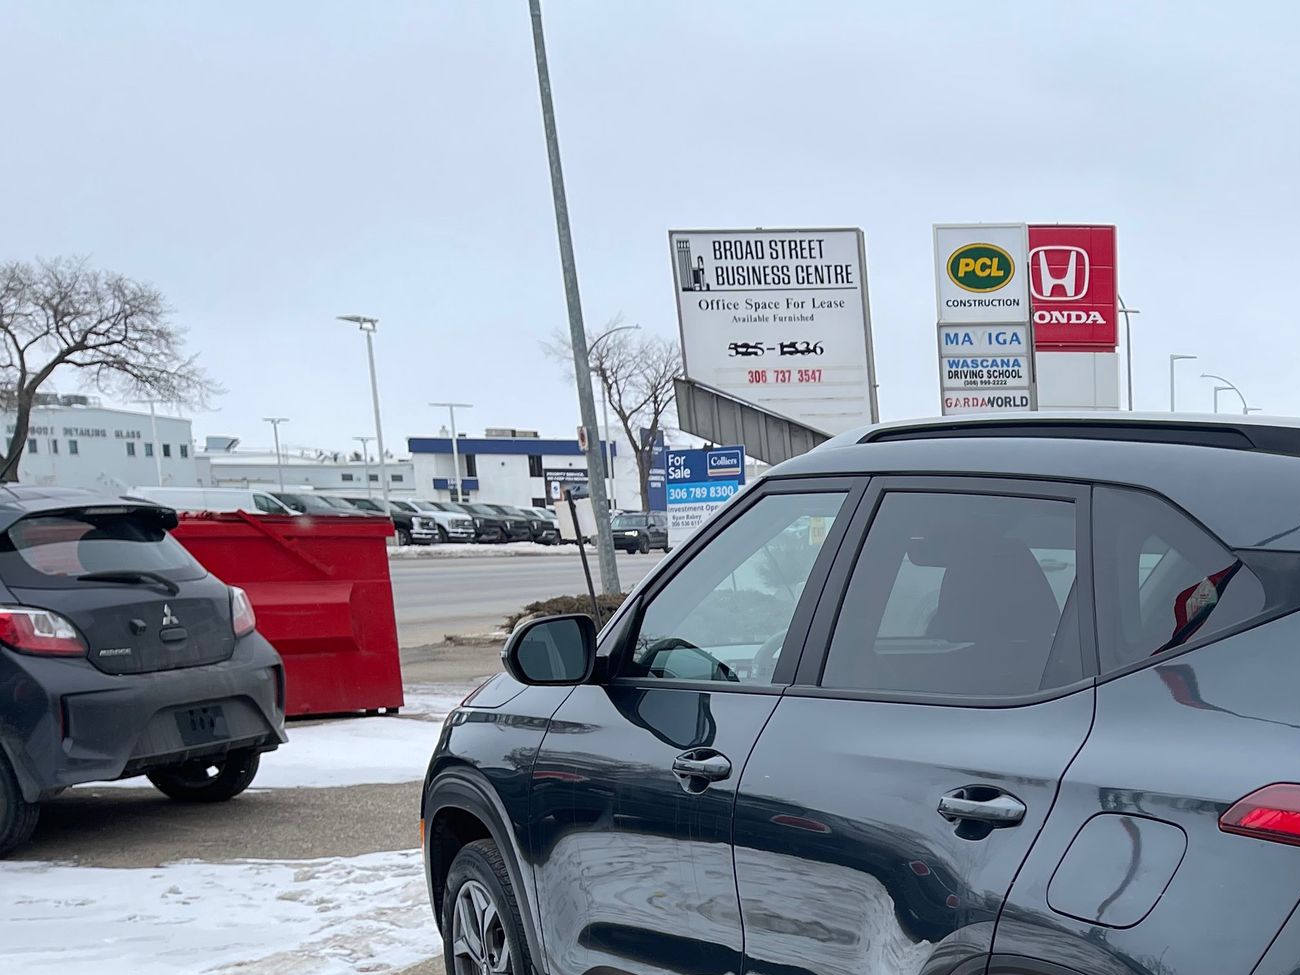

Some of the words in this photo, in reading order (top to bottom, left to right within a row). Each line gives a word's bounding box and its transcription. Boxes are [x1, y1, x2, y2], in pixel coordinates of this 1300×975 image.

[712, 239, 765, 261] BROAD
[769, 238, 825, 260] STREET
[958, 257, 1004, 278] PCL
[715, 264, 791, 287] BUSINESS
[795, 263, 854, 285] CENTRE
[698, 298, 740, 311] Office
[744, 298, 780, 313] Space
[785, 297, 806, 310] For
[811, 297, 846, 309] Lease
[945, 298, 1020, 308] CONSTRUCTION
[731, 315, 770, 324] Available
[772, 313, 815, 323] Furnished
[1033, 310, 1107, 325] ONDA
[947, 358, 1022, 369] WASCANA
[747, 369, 768, 384] 306
[773, 369, 792, 383] 737
[797, 368, 823, 383] 3547
[947, 369, 985, 380] DRIVING
[987, 369, 1023, 380] SCHOOL
[945, 395, 1029, 409] GARDAWORLD
[668, 454, 686, 467] For
[710, 456, 738, 467] Colliers
[668, 466, 691, 480] Sale
[669, 489, 687, 500] 306
[689, 487, 707, 499] 789
[709, 485, 734, 498] 8300
